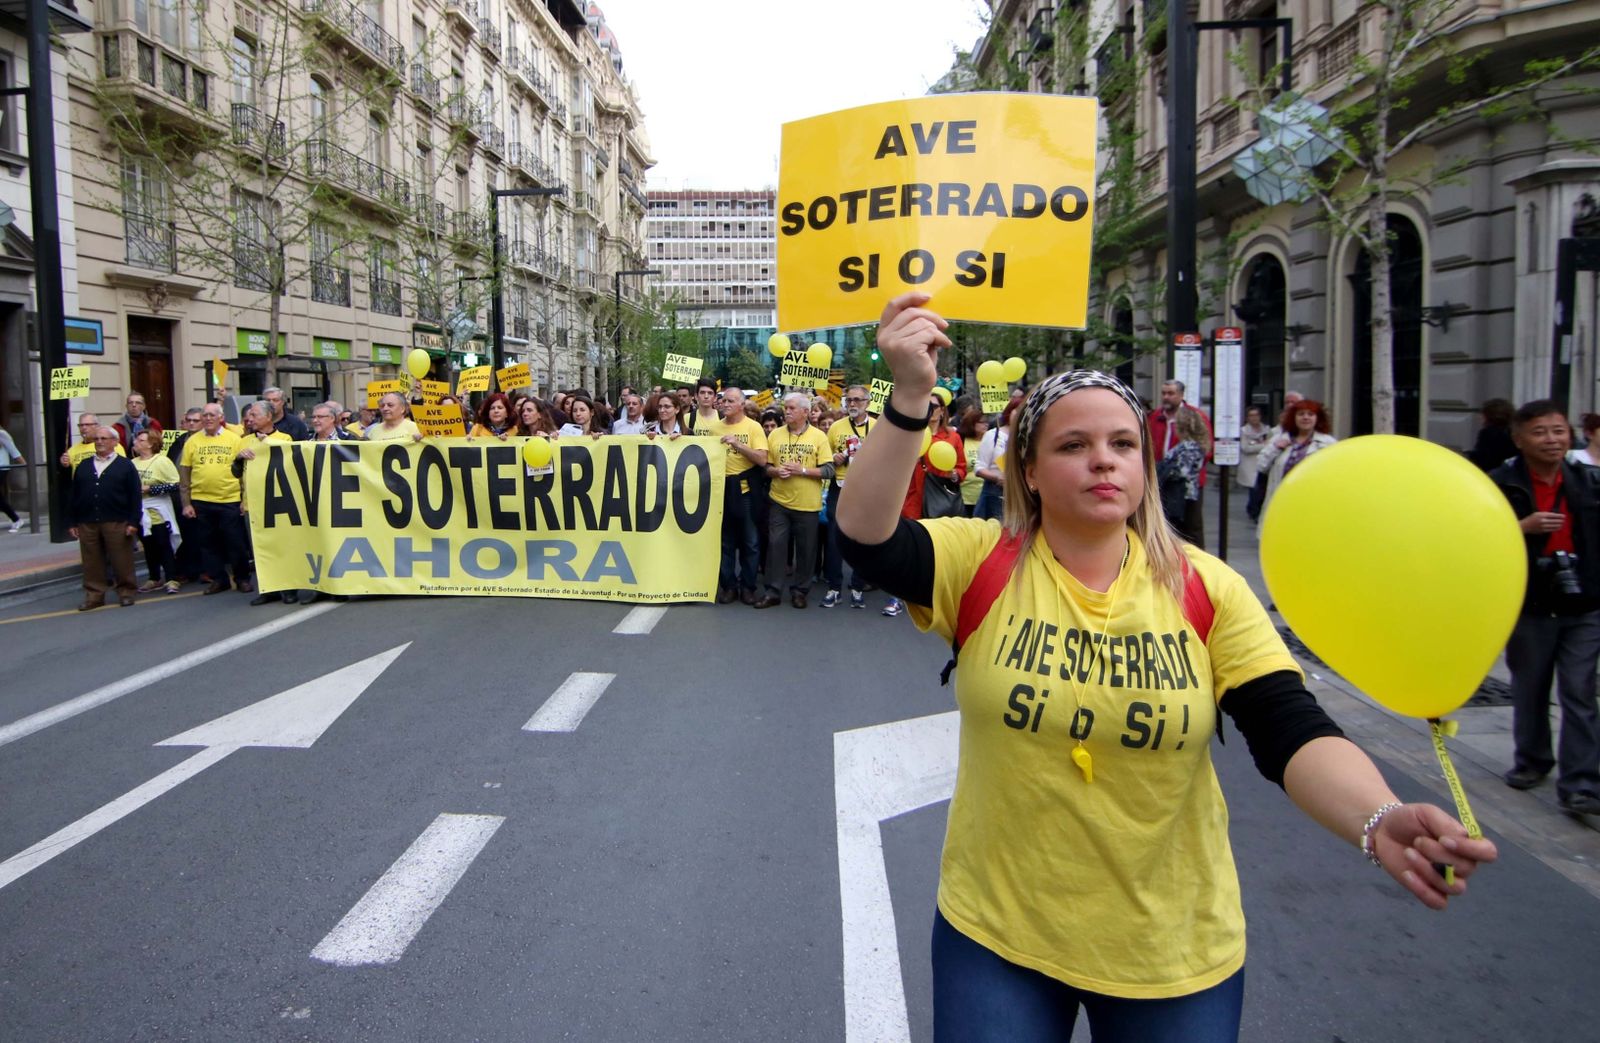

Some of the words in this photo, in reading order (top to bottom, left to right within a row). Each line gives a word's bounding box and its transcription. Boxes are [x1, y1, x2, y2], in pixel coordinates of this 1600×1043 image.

[874, 120, 977, 160] AVE
[780, 182, 1089, 236] SOTERRADO
[838, 253, 880, 293] SI
[898, 249, 936, 285] O
[954, 250, 1006, 289] SI
[667, 355, 687, 364] AVE
[785, 351, 809, 364] AVE
[53, 368, 74, 378] AVE
[665, 363, 701, 377] SOTERRADO
[782, 364, 829, 380] SOTERRADO
[499, 371, 531, 383] SOTERRADO
[51, 378, 90, 391] SOTERRADO
[873, 380, 894, 392] AVE
[264, 444, 362, 529] AVE
[382, 444, 711, 535] SOTERRADO
[305, 553, 323, 585] y
[328, 537, 638, 585] AHORA
[580, 589, 612, 597] Juventud
